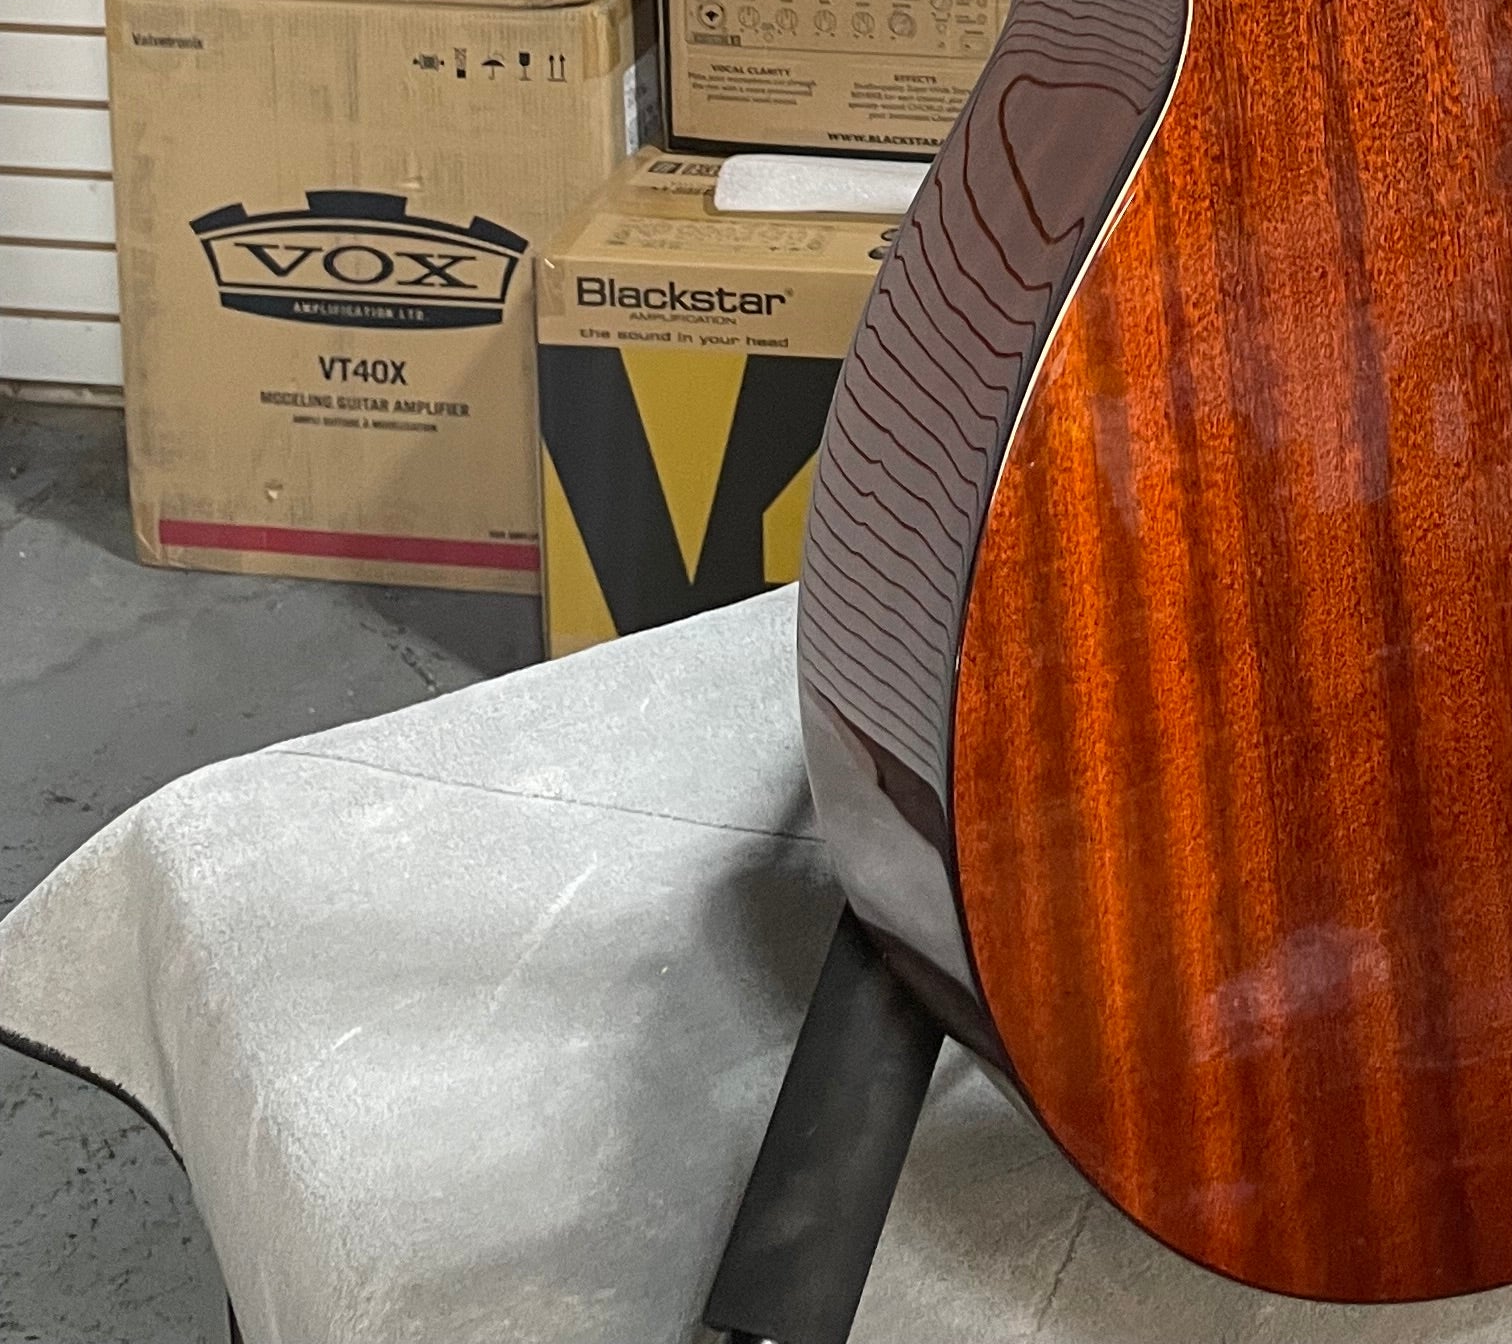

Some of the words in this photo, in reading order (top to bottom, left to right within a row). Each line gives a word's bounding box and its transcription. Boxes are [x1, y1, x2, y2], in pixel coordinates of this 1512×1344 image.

[234, 242, 478, 289] VOX
[576, 275, 786, 316] Blackstar
[630, 313, 737, 325] AMPLIFICATION
[580, 328, 610, 340] the
[617, 330, 671, 343] sound
[678, 331, 692, 344] in
[699, 334, 740, 347] your
[746, 336, 788, 348] head
[319, 356, 408, 386] VT40X
